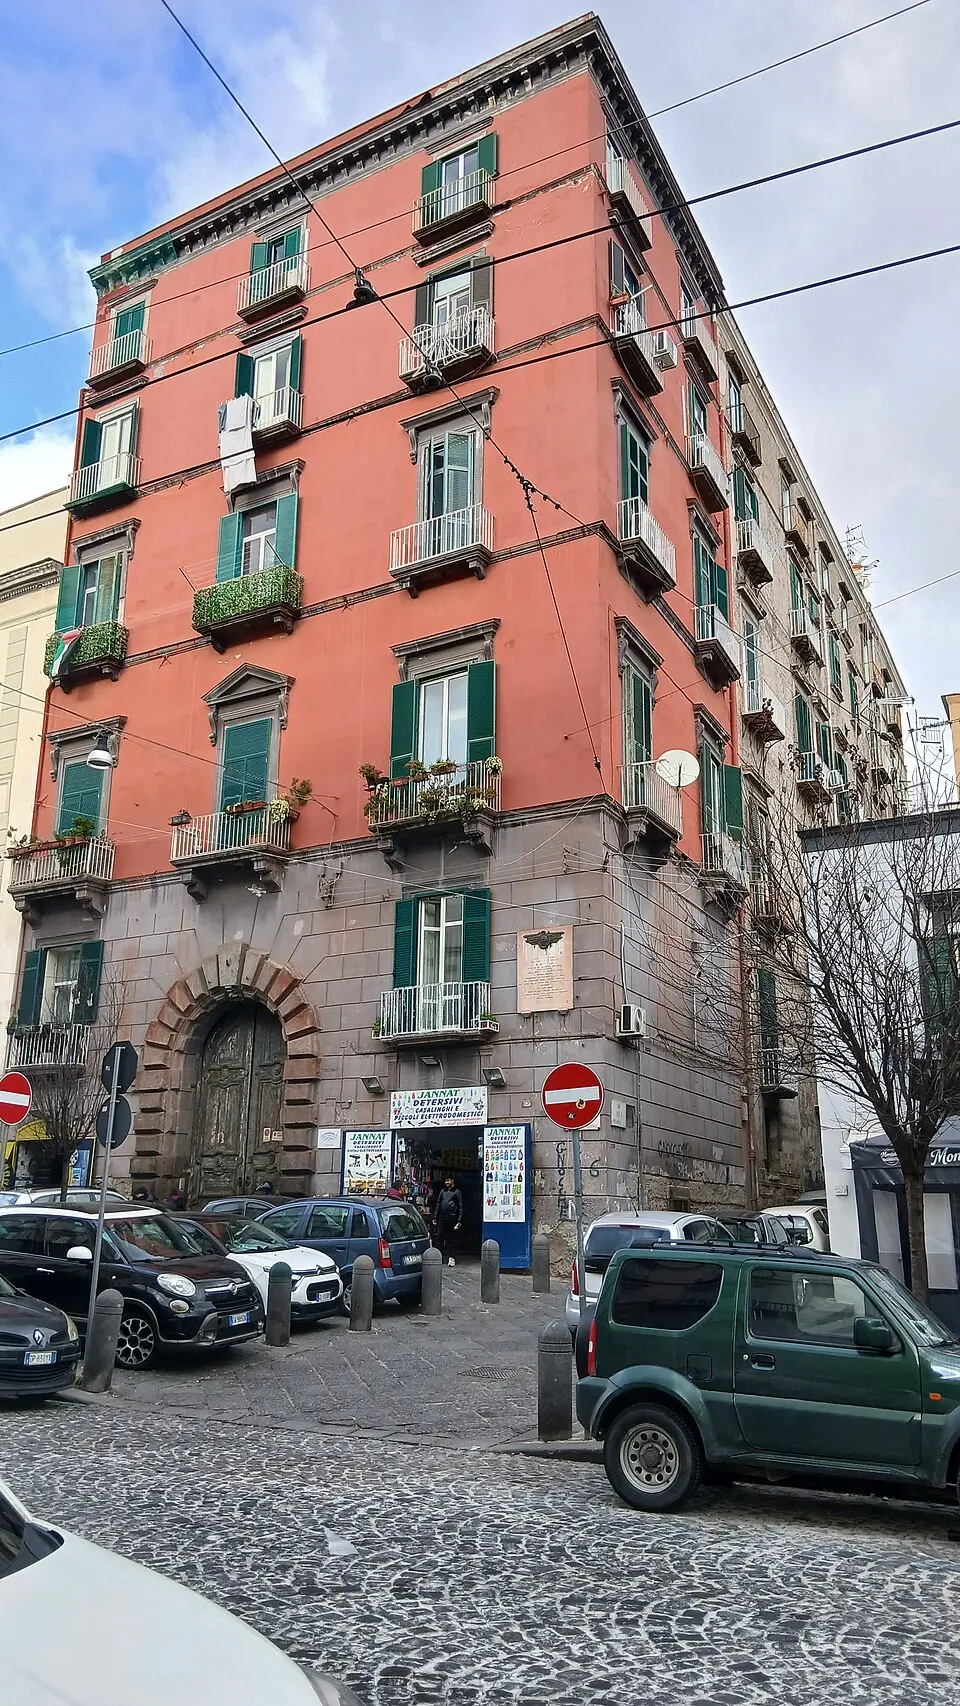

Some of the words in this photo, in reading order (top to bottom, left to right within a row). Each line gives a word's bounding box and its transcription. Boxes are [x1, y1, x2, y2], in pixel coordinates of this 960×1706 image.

[417, 1089, 460, 1099] JANNAT
[413, 1097, 463, 1107] DETERSIVI
[420, 1111, 484, 1120] ELETTRODOMESTICI
[349, 1133, 387, 1141] JANNAT
[487, 1127, 521, 1137] JANNAT
